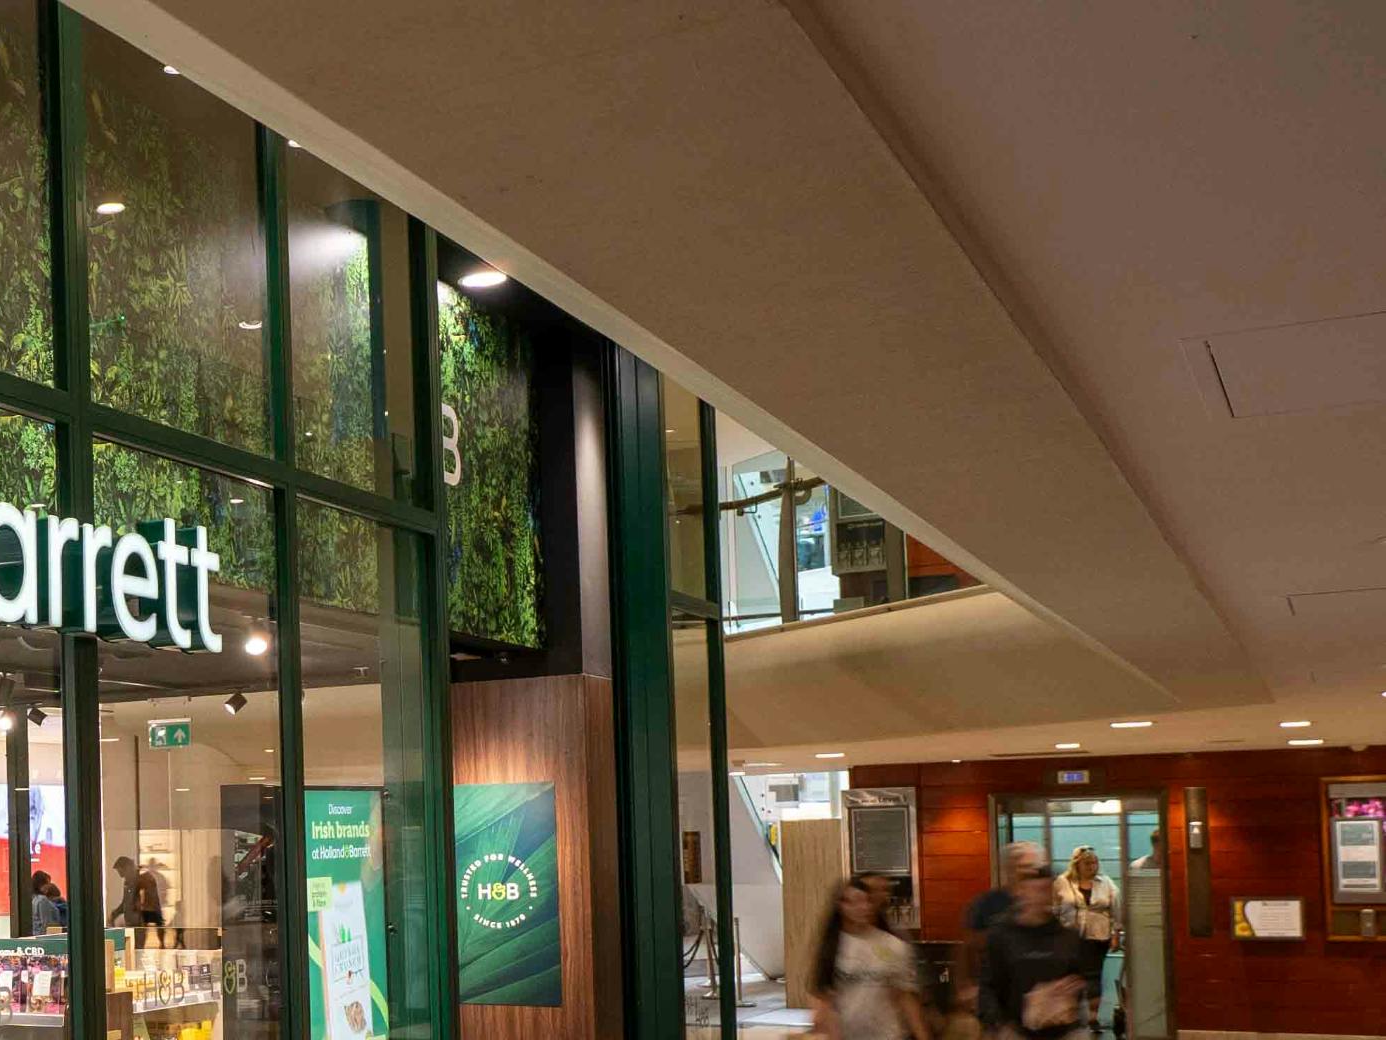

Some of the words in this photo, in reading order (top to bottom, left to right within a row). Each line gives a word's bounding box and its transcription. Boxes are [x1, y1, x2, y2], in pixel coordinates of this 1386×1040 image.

[328, 803, 352, 815] Discover
[311, 821, 334, 839] Irish
[336, 820, 370, 838] brands
[484, 853, 504, 863] FOR
[477, 882, 519, 900] H&B
[473, 913, 502, 929] SINCE
[505, 913, 526, 928] 1870
[24, 946, 45, 957] CBD
